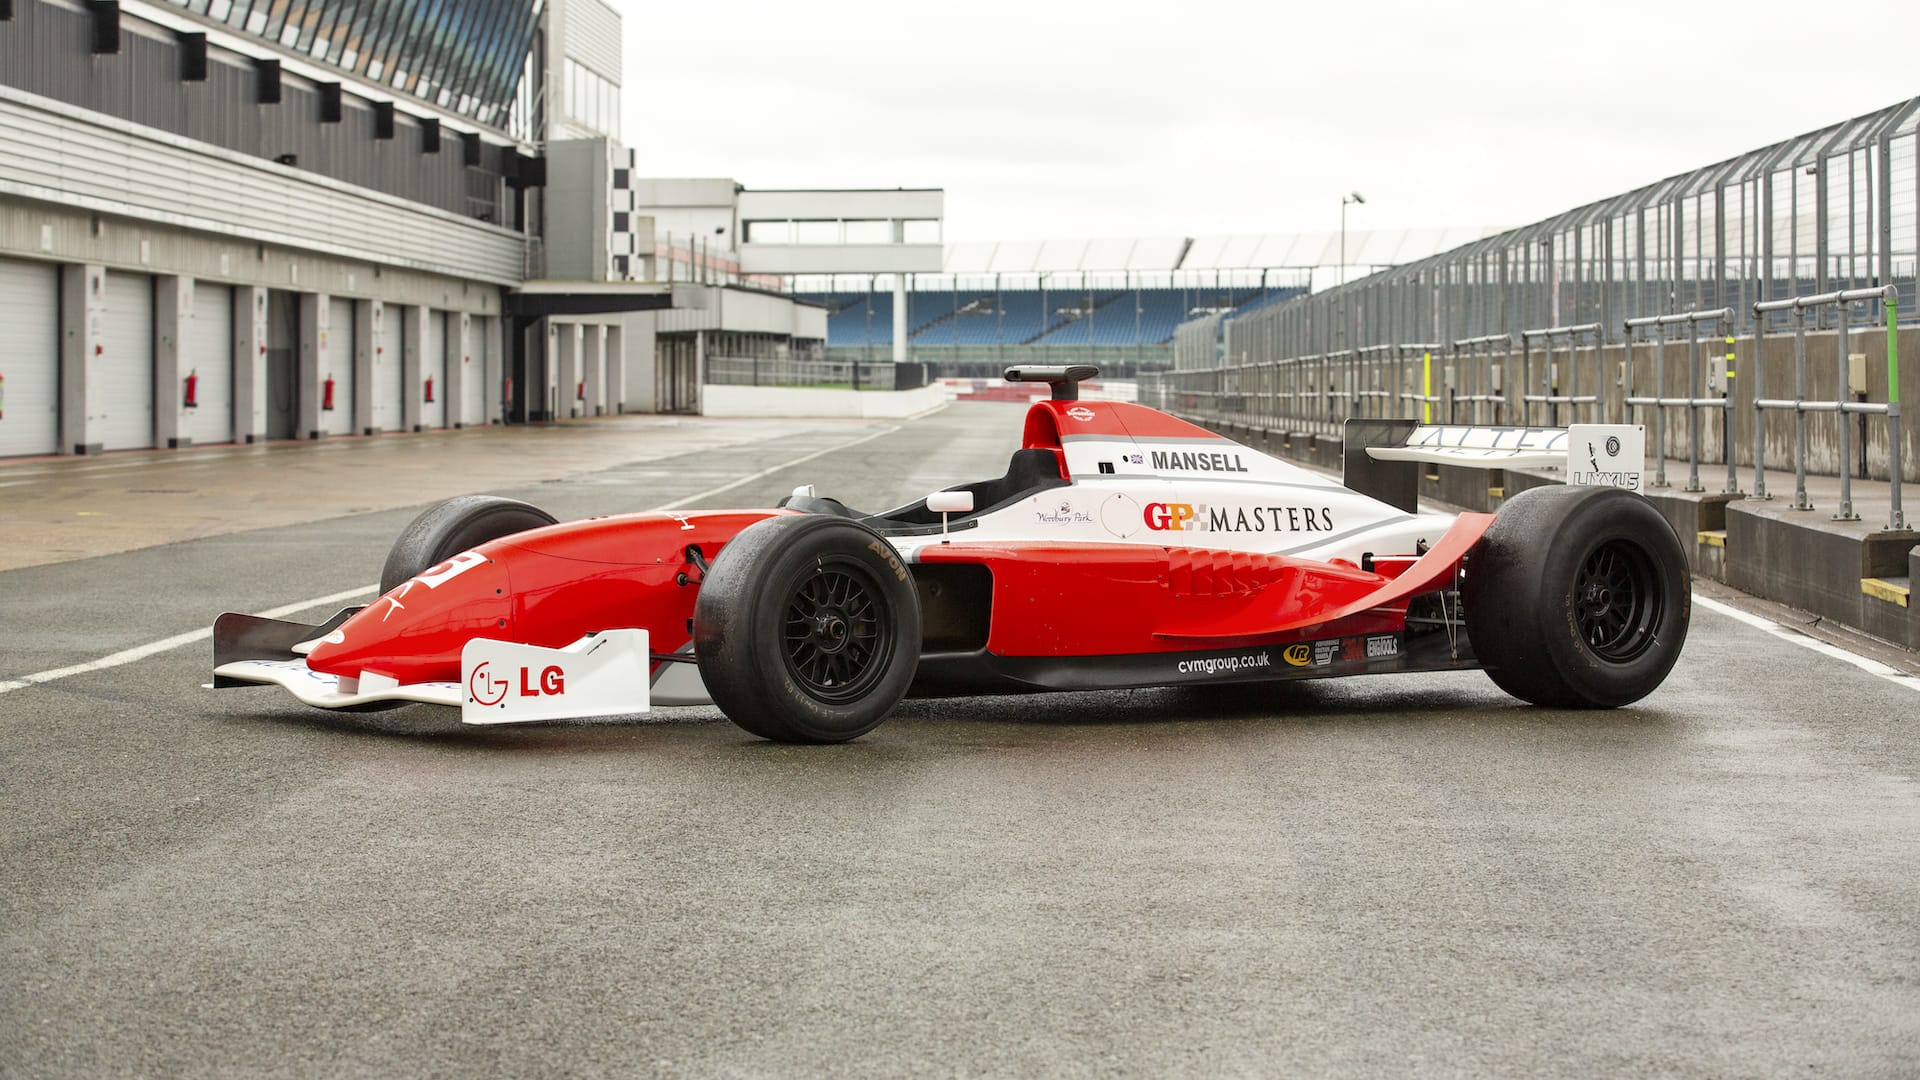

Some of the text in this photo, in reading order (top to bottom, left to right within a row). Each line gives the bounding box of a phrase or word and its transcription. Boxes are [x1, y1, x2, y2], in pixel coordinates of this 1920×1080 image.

[1151, 451, 1248, 472] MANSELL
[1143, 502, 1334, 532] GP MASTERS
[867, 540, 906, 581] AVON
[1178, 651, 1270, 674] cvmgroup.co.uk
[520, 665, 565, 697] LG
